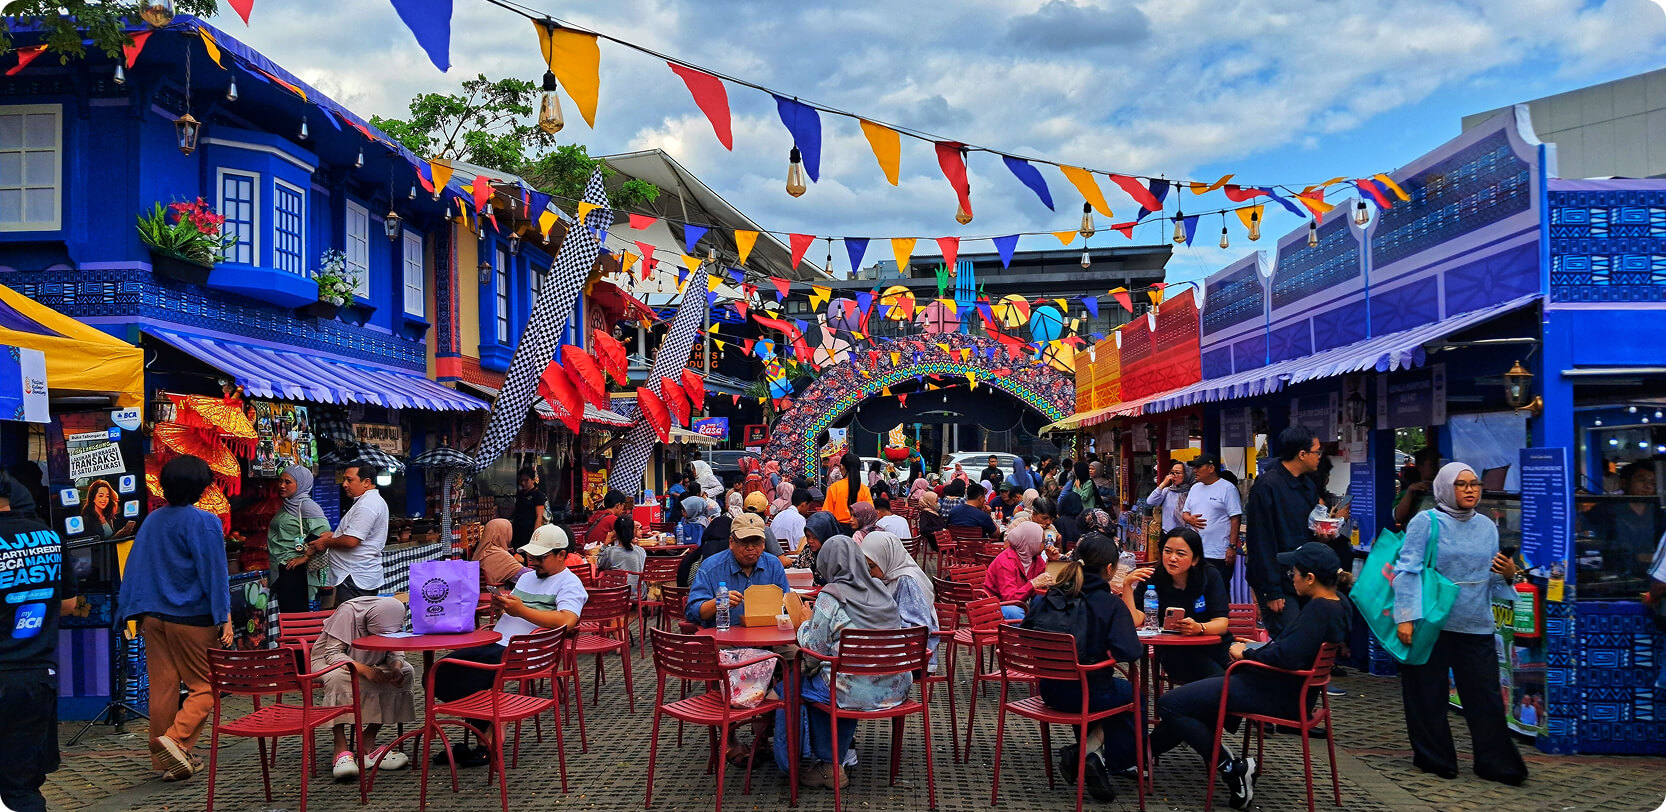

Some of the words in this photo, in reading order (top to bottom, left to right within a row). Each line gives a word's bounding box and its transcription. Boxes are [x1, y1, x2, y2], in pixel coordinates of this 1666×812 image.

[695, 352, 718, 360] HIS
[699, 424, 722, 435] Rasa
[71, 452, 120, 470] TRANSAKSI
[77, 467, 92, 475] SATU
[93, 461, 121, 472] APLIKASI
[29, 546, 62, 557] KREDIT
[25, 553, 62, 567] MAKIN
[0, 564, 62, 589] EASY!
[15, 617, 43, 630] BCA
